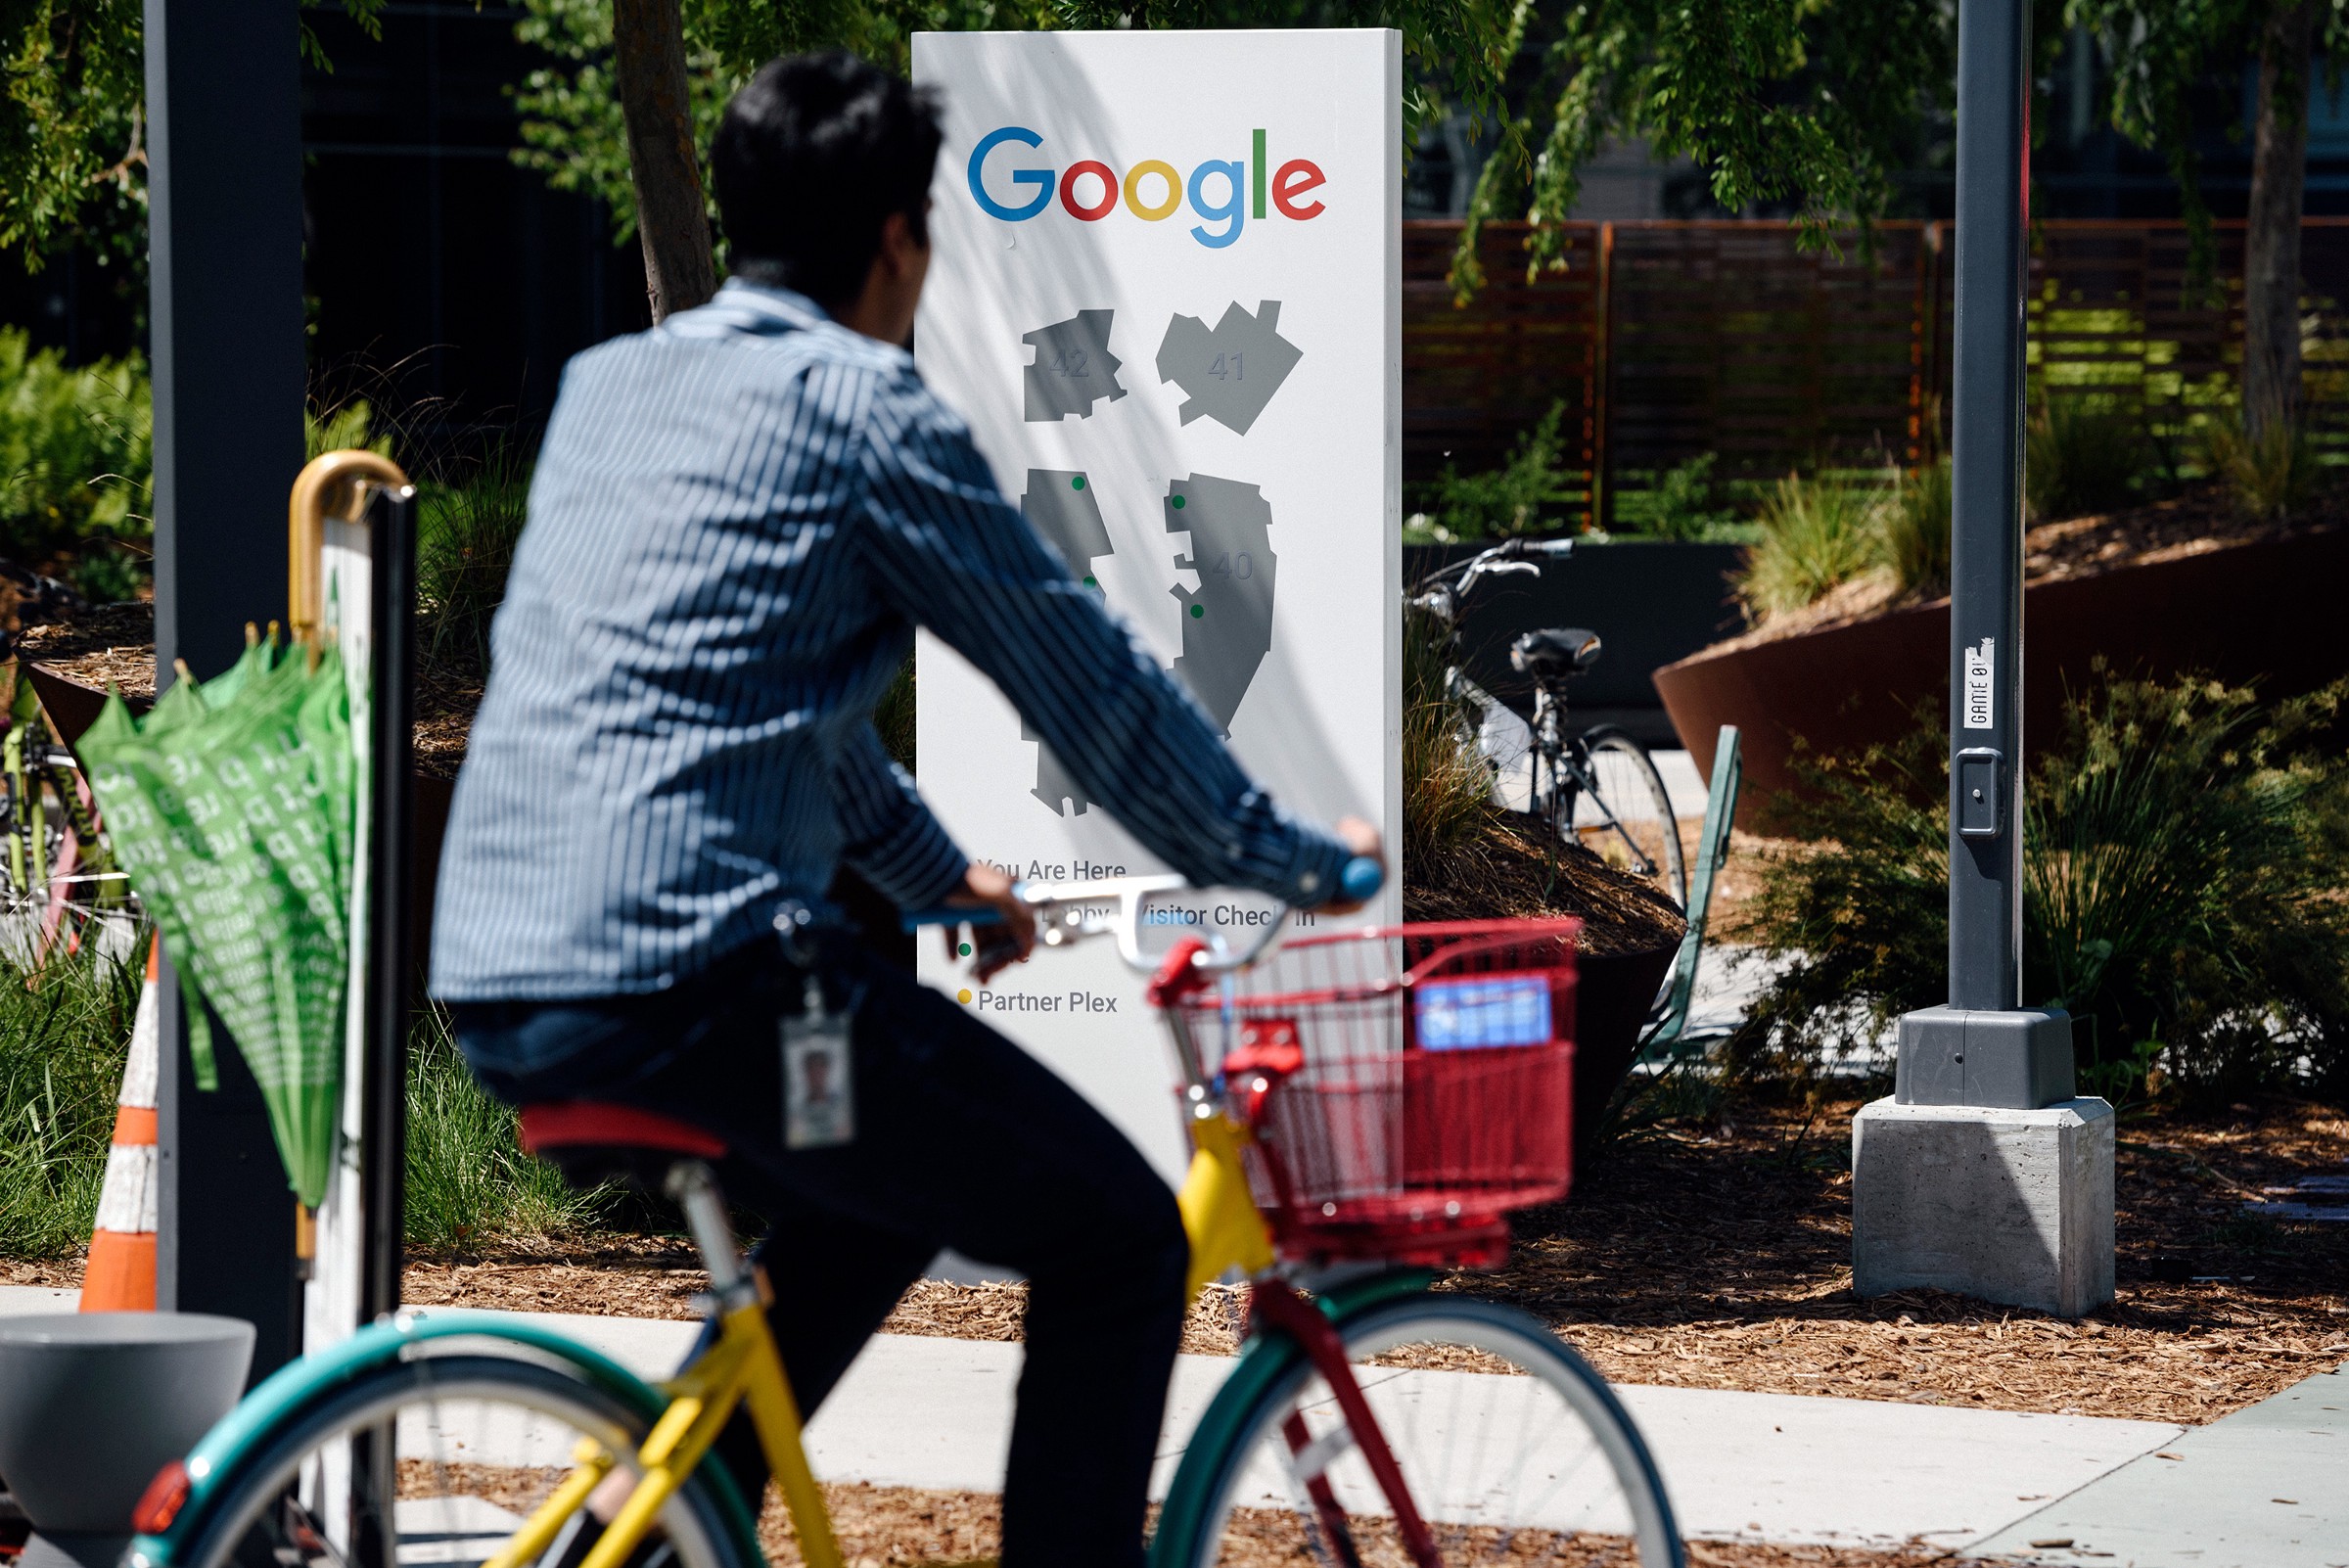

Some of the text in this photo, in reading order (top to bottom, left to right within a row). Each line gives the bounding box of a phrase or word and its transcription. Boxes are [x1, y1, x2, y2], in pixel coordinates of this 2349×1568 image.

[967, 126, 1327, 250] Google
[1049, 349, 1090, 379] 42
[1208, 351, 1245, 382] 41
[1212, 551, 1254, 580] 40
[1027, 859, 1066, 880] Are
[1073, 860, 1127, 880] Here
[1041, 901, 1110, 925] Lbby
[978, 990, 1118, 1013] Partner Plex
